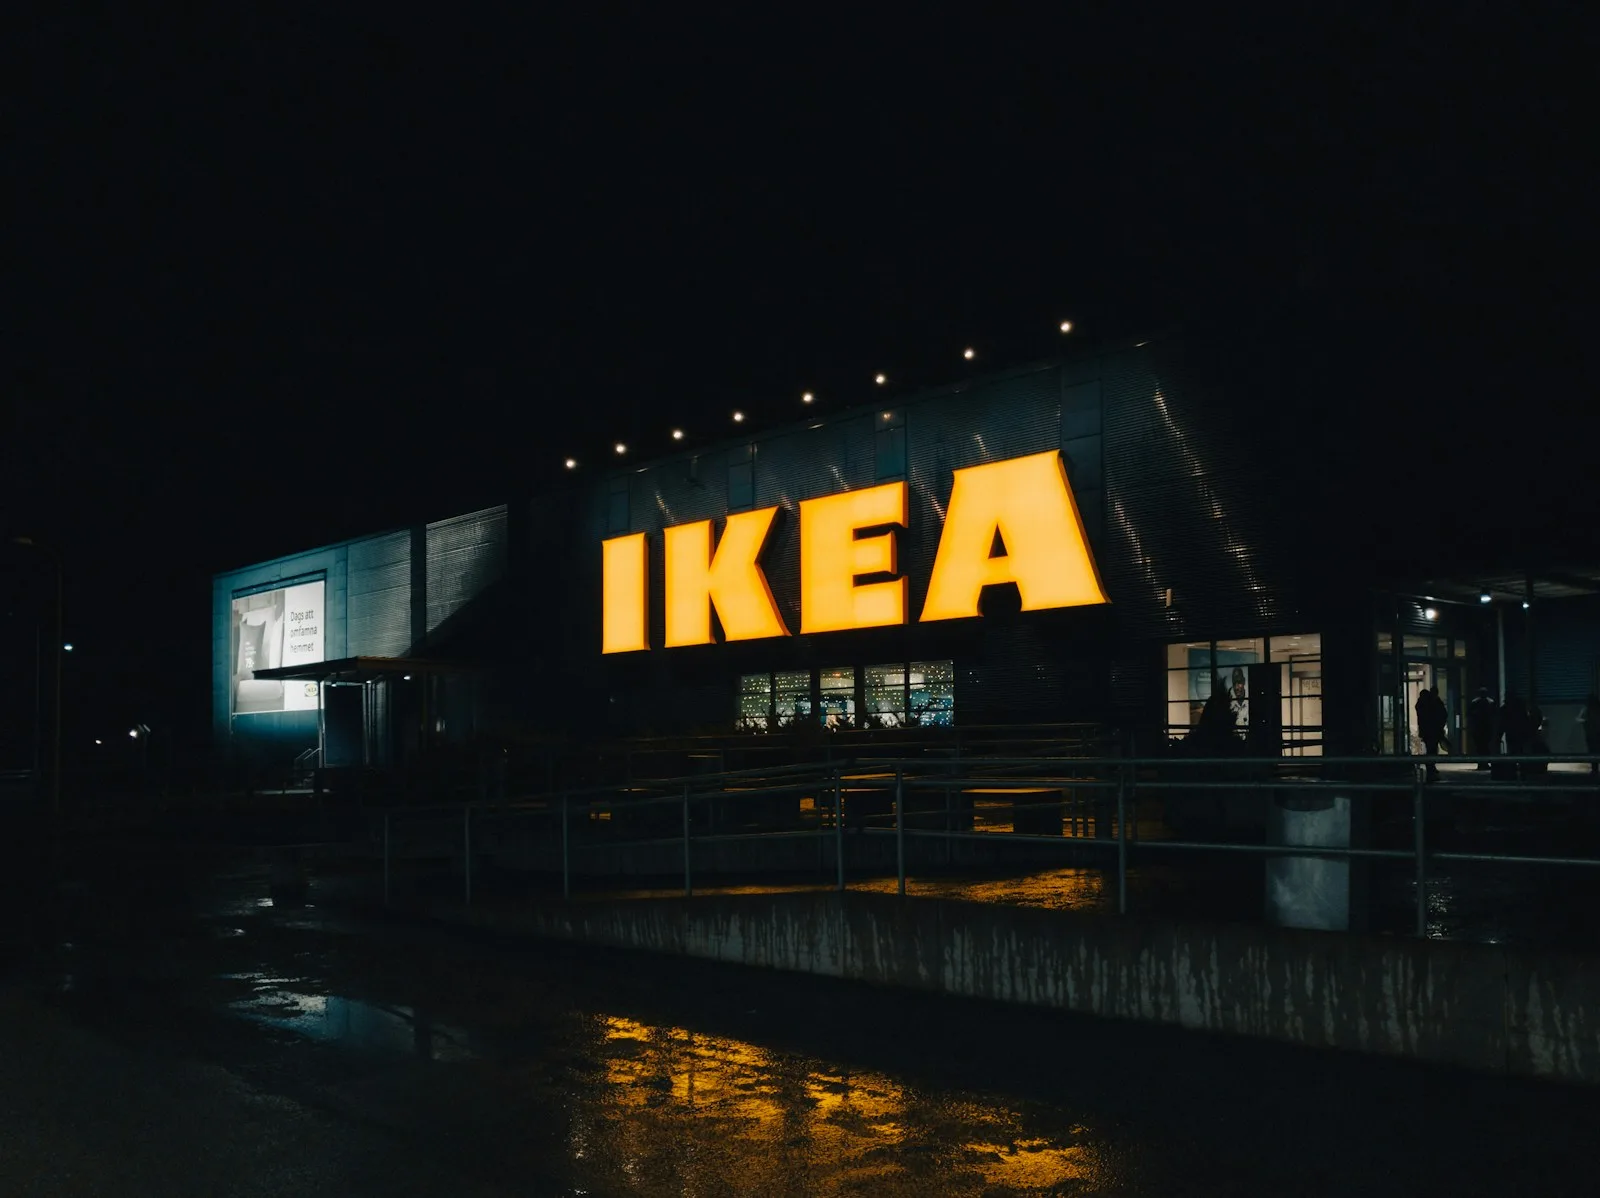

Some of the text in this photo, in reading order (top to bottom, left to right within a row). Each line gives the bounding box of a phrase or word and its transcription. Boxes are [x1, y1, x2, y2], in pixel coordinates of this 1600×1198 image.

[601, 449, 1111, 655] IKEA
[290, 609, 314, 624] Dags att
[290, 625, 318, 638] omfamna
[290, 642, 314, 653] hemmet
